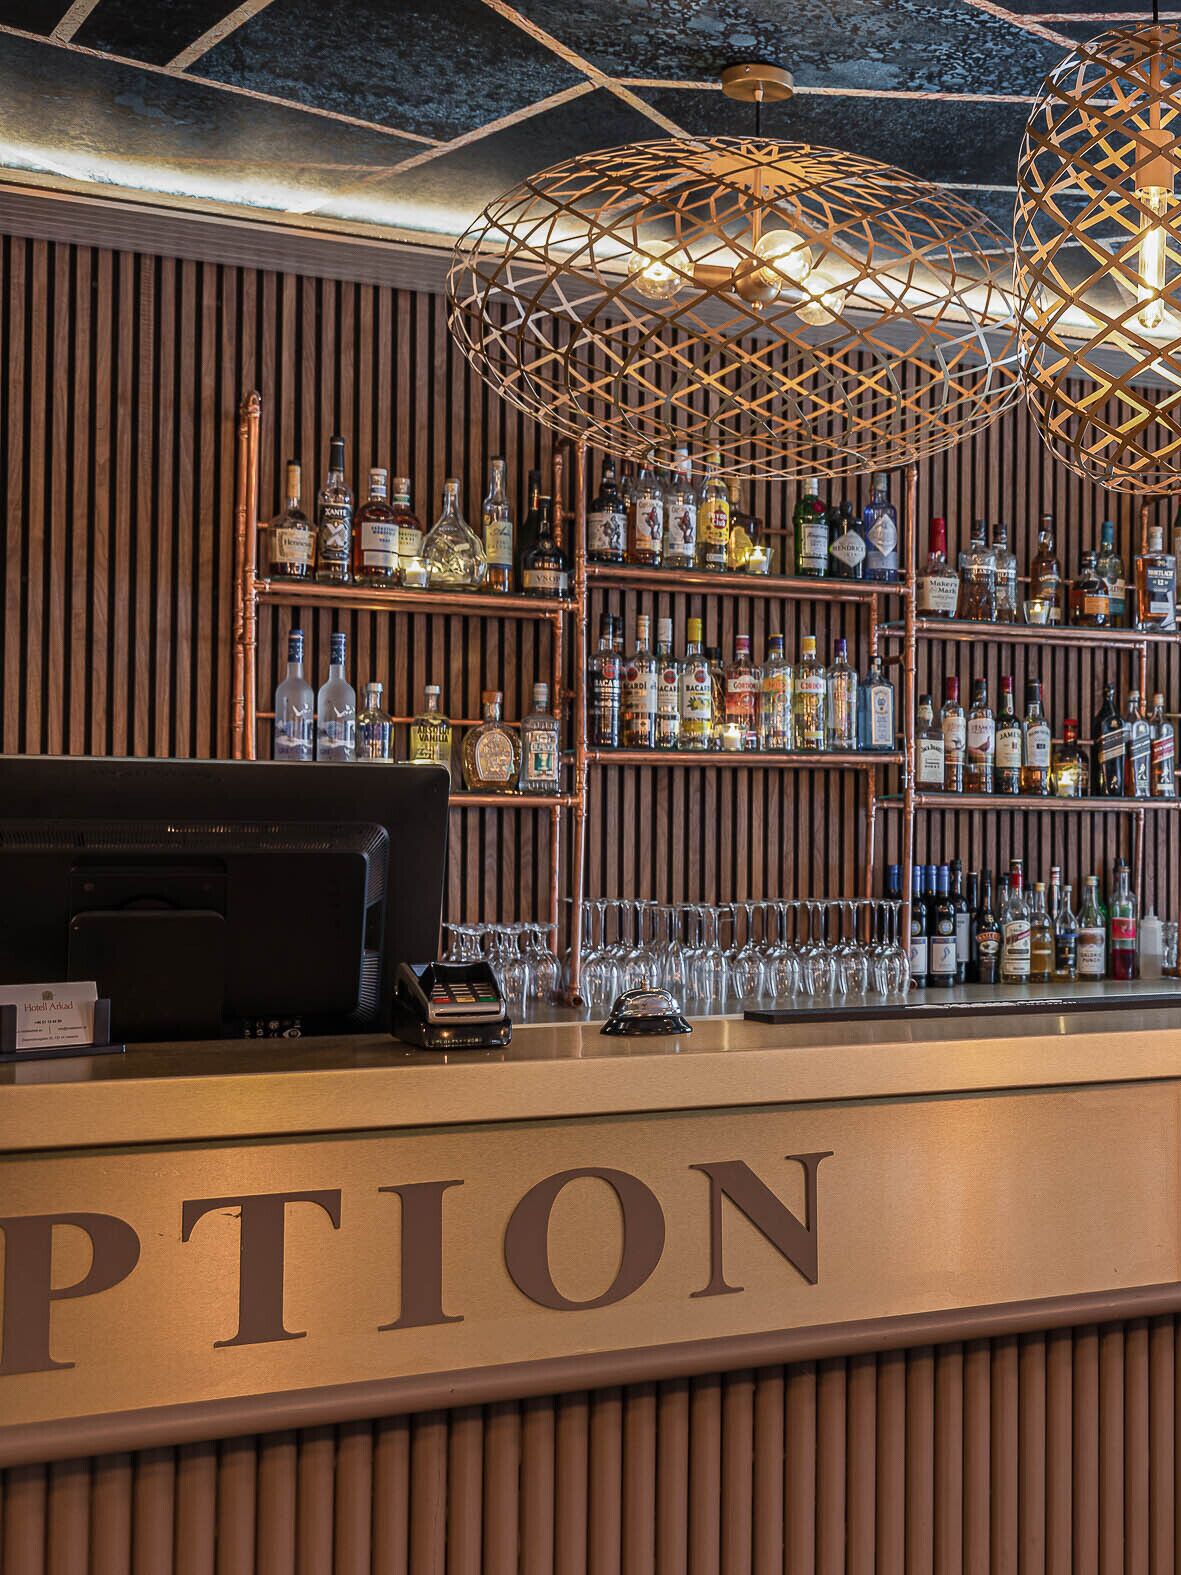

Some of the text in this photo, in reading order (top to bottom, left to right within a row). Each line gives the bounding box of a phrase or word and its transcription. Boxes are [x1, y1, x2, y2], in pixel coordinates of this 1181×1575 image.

[24, 1000, 74, 1013] Hotell Arkad
[0, 1150, 834, 1376] PTION
